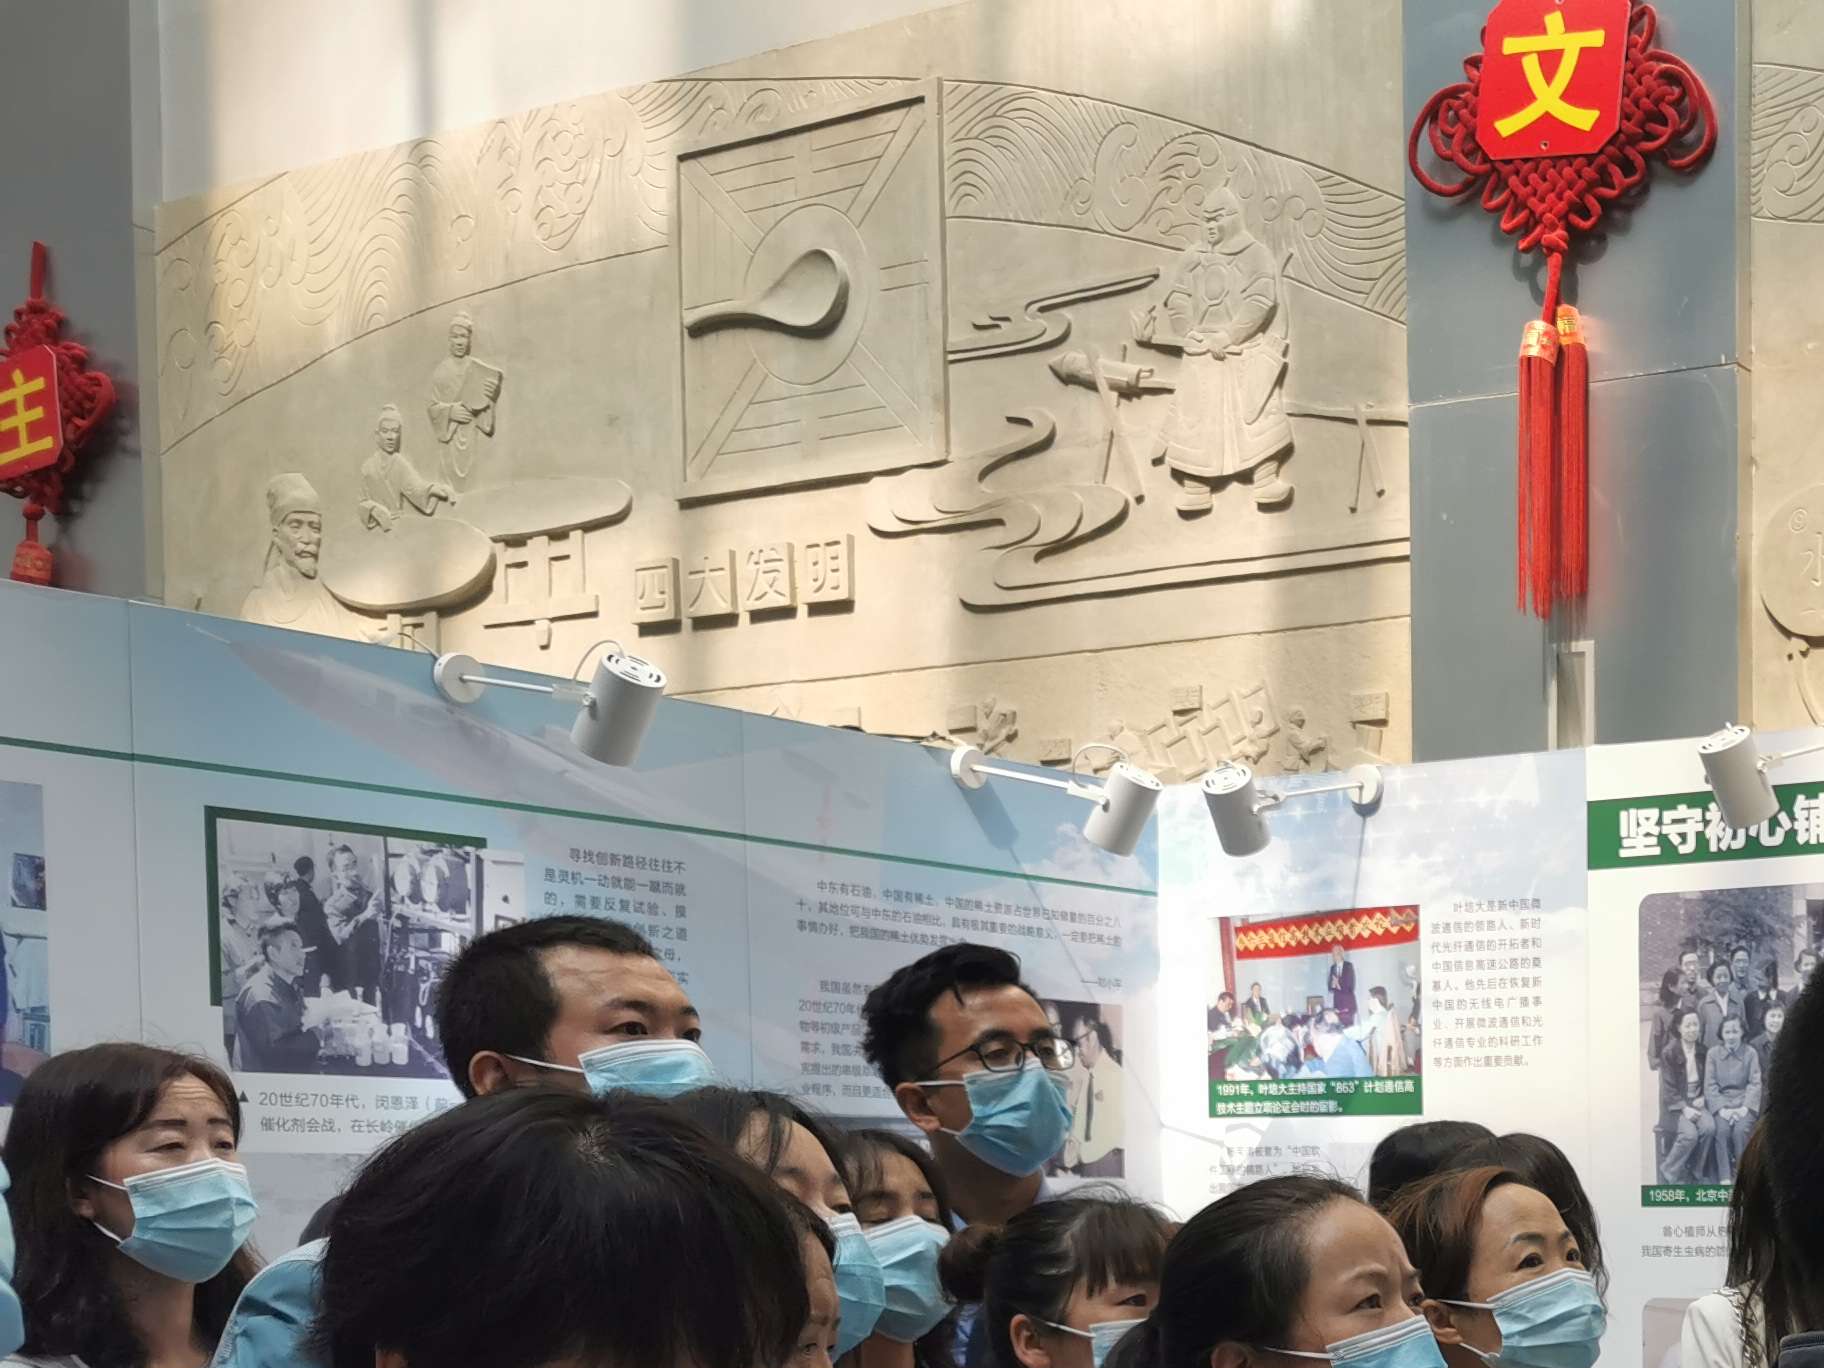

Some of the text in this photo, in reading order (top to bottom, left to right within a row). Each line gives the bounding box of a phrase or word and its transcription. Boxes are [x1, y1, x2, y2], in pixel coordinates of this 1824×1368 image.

[1494, 10, 1605, 138] 文
[634, 538, 842, 612] 四大发明
[1649, 1189, 1732, 1202] 1958年，北京中
